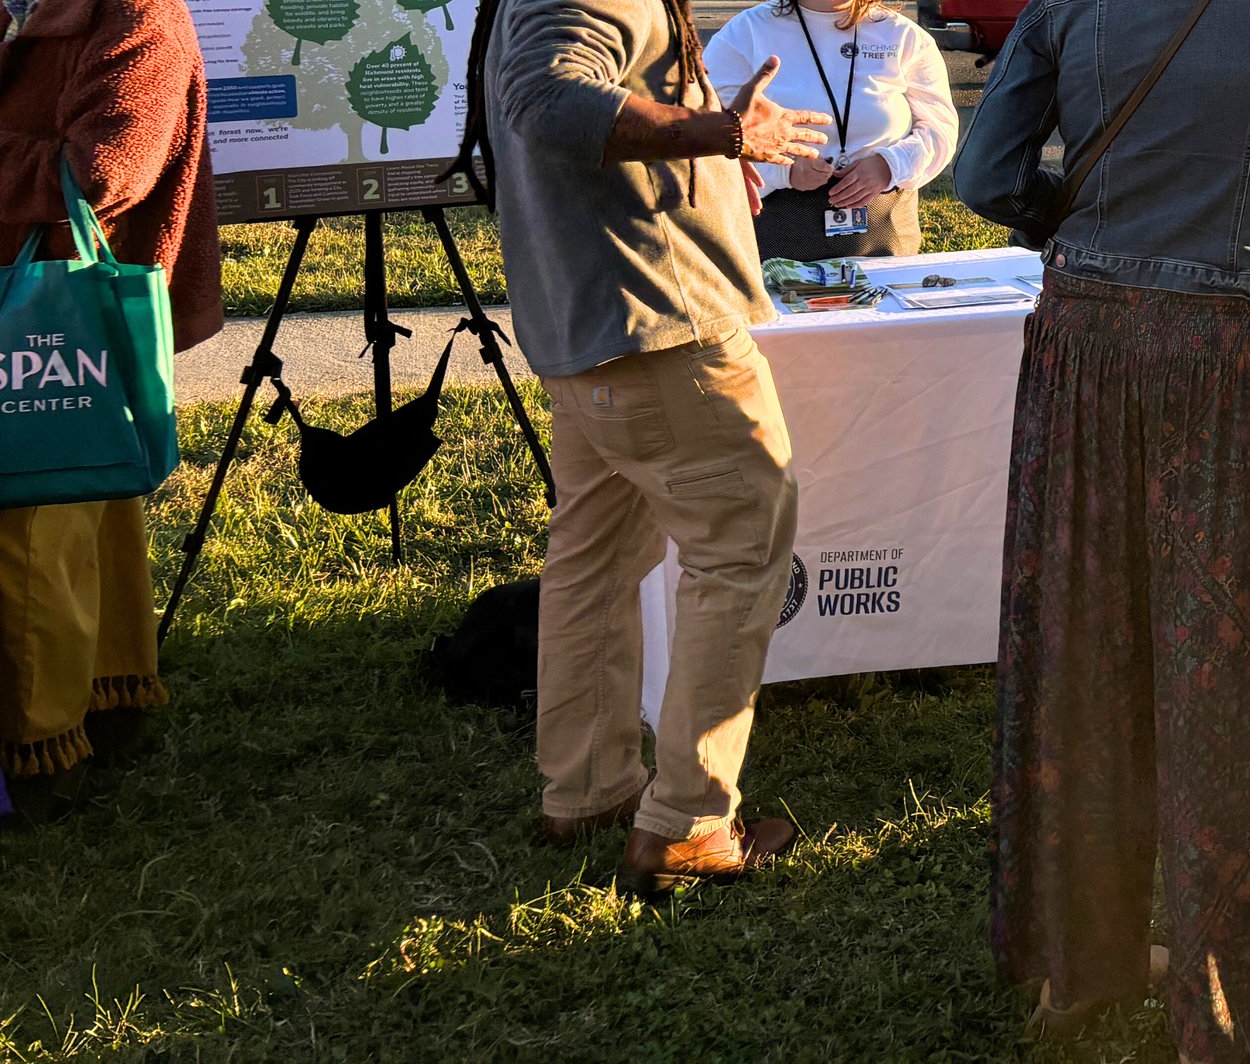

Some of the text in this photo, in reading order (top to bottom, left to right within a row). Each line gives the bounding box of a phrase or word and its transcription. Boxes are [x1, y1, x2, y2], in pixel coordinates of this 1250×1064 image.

[250, 134, 288, 142] connected
[362, 178, 380, 200] 2
[452, 172, 469, 194] 3
[263, 187, 281, 209] 1
[26, 334, 65, 347] THE
[1, 396, 92, 413] CENTER
[820, 548, 904, 563] DEPARTMENT OF
[819, 566, 898, 590] PUBLIC
[782, 600, 799, 618] 1737
[817, 591, 900, 616] WORKS
